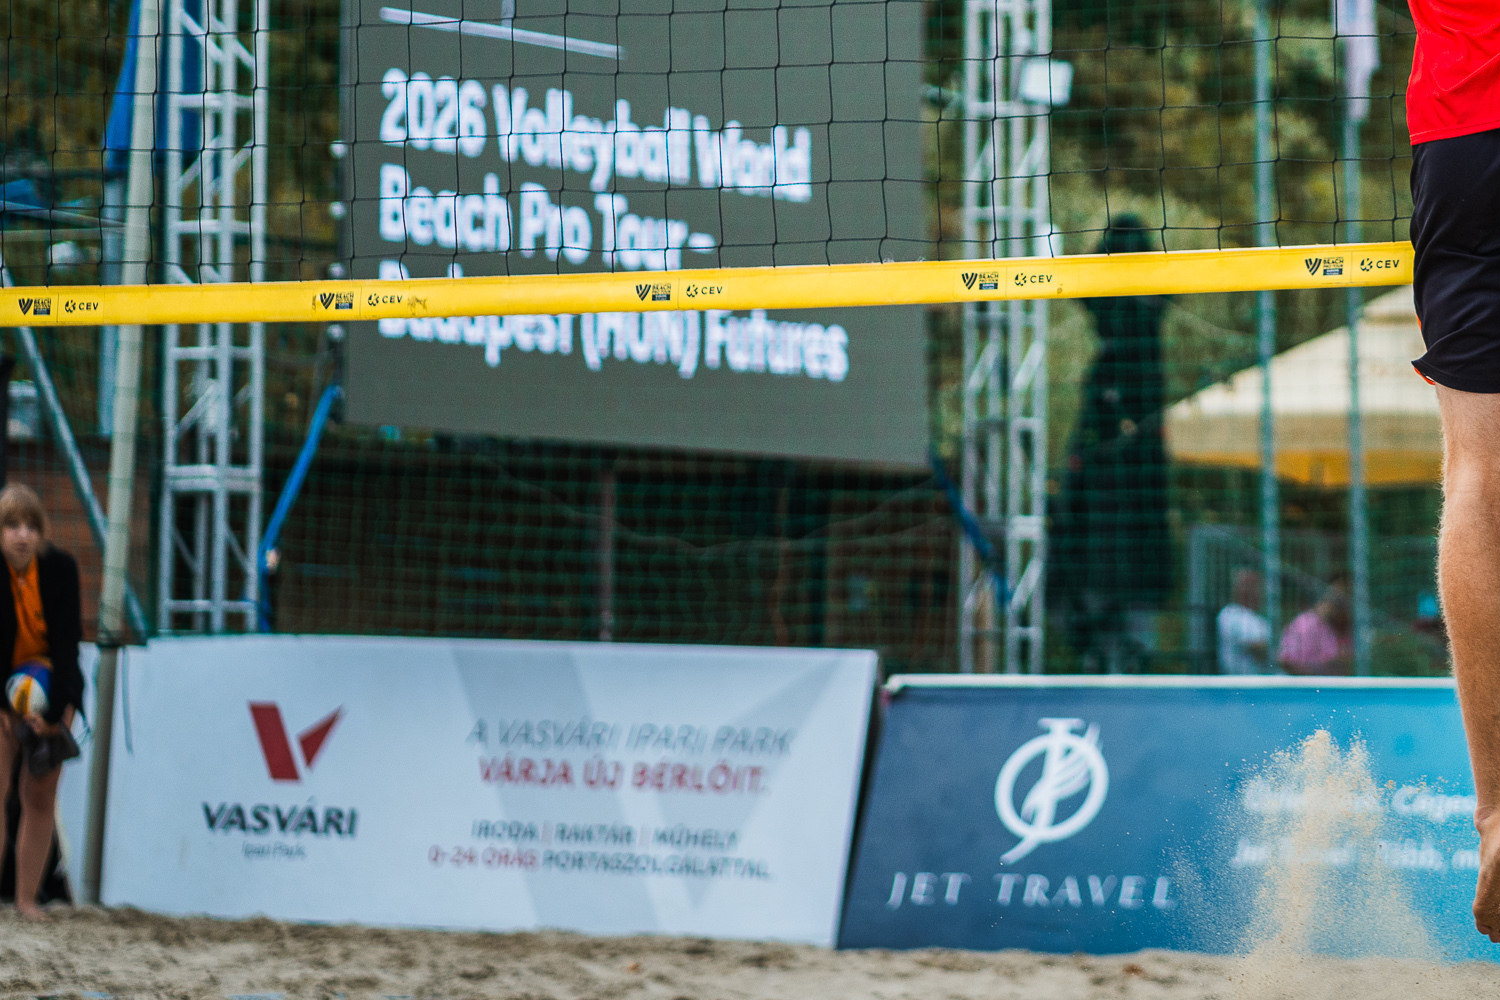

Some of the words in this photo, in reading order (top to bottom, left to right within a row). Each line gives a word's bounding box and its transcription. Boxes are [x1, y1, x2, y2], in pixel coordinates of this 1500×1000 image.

[379, 68, 487, 157] 2026
[492, 83, 691, 191] Volleyball
[694, 114, 812, 202] World
[379, 163, 511, 252] Beach
[519, 181, 592, 265] Pro
[1376, 259, 1400, 269] CEV
[701, 286, 723, 295] CEV
[1030, 274, 1053, 283] CEV
[78, 302, 99, 311] CEV
[382, 295, 403, 304] CEV
[704, 308, 850, 382] Futures
[202, 795, 358, 837] VASVÁRI
[886, 871, 972, 911] JET
[993, 872, 1178, 909] TRAVEL
